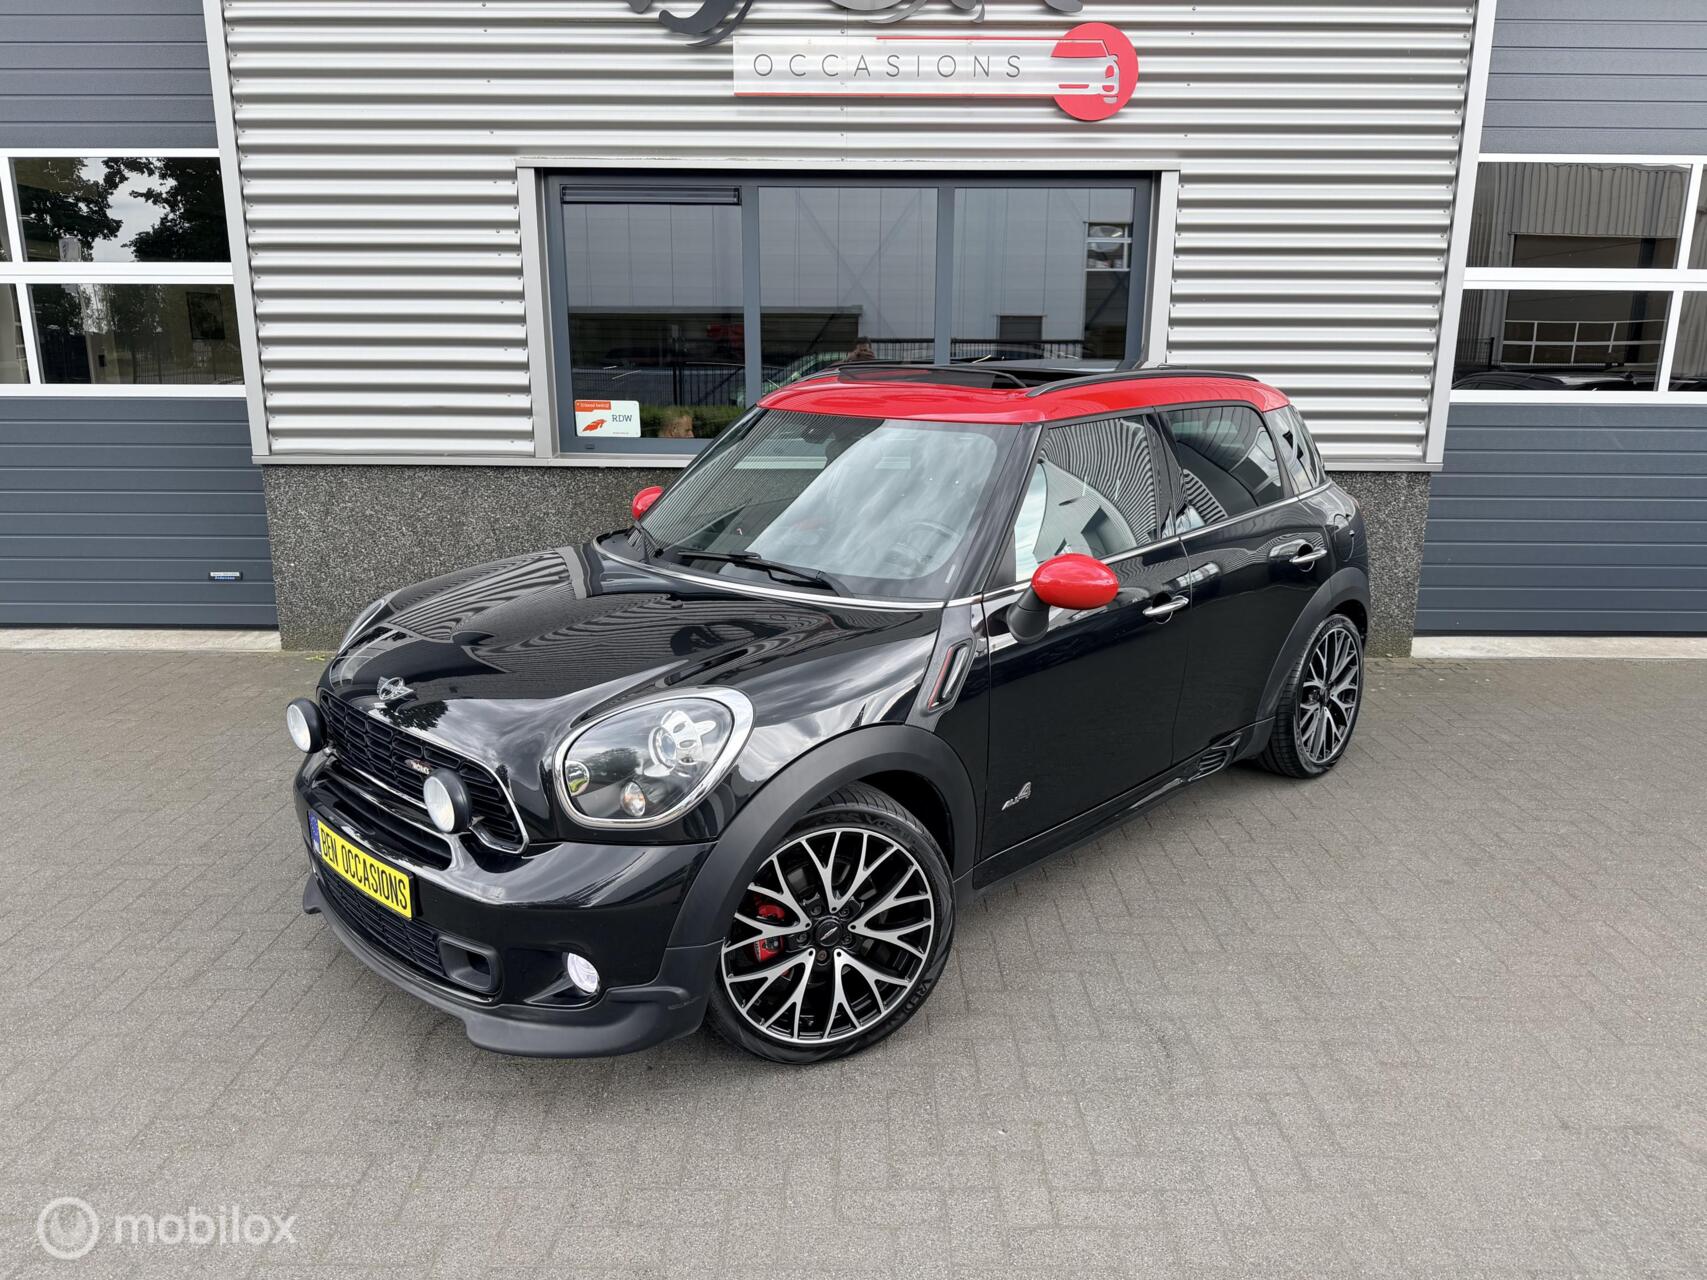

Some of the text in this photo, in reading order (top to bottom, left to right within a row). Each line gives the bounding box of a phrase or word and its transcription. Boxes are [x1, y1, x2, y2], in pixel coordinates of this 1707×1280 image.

[752, 53, 1022, 78] OCCASIONS
[611, 414, 633, 423] RDW
[320, 828, 408, 911] BEN OCCASIONS
